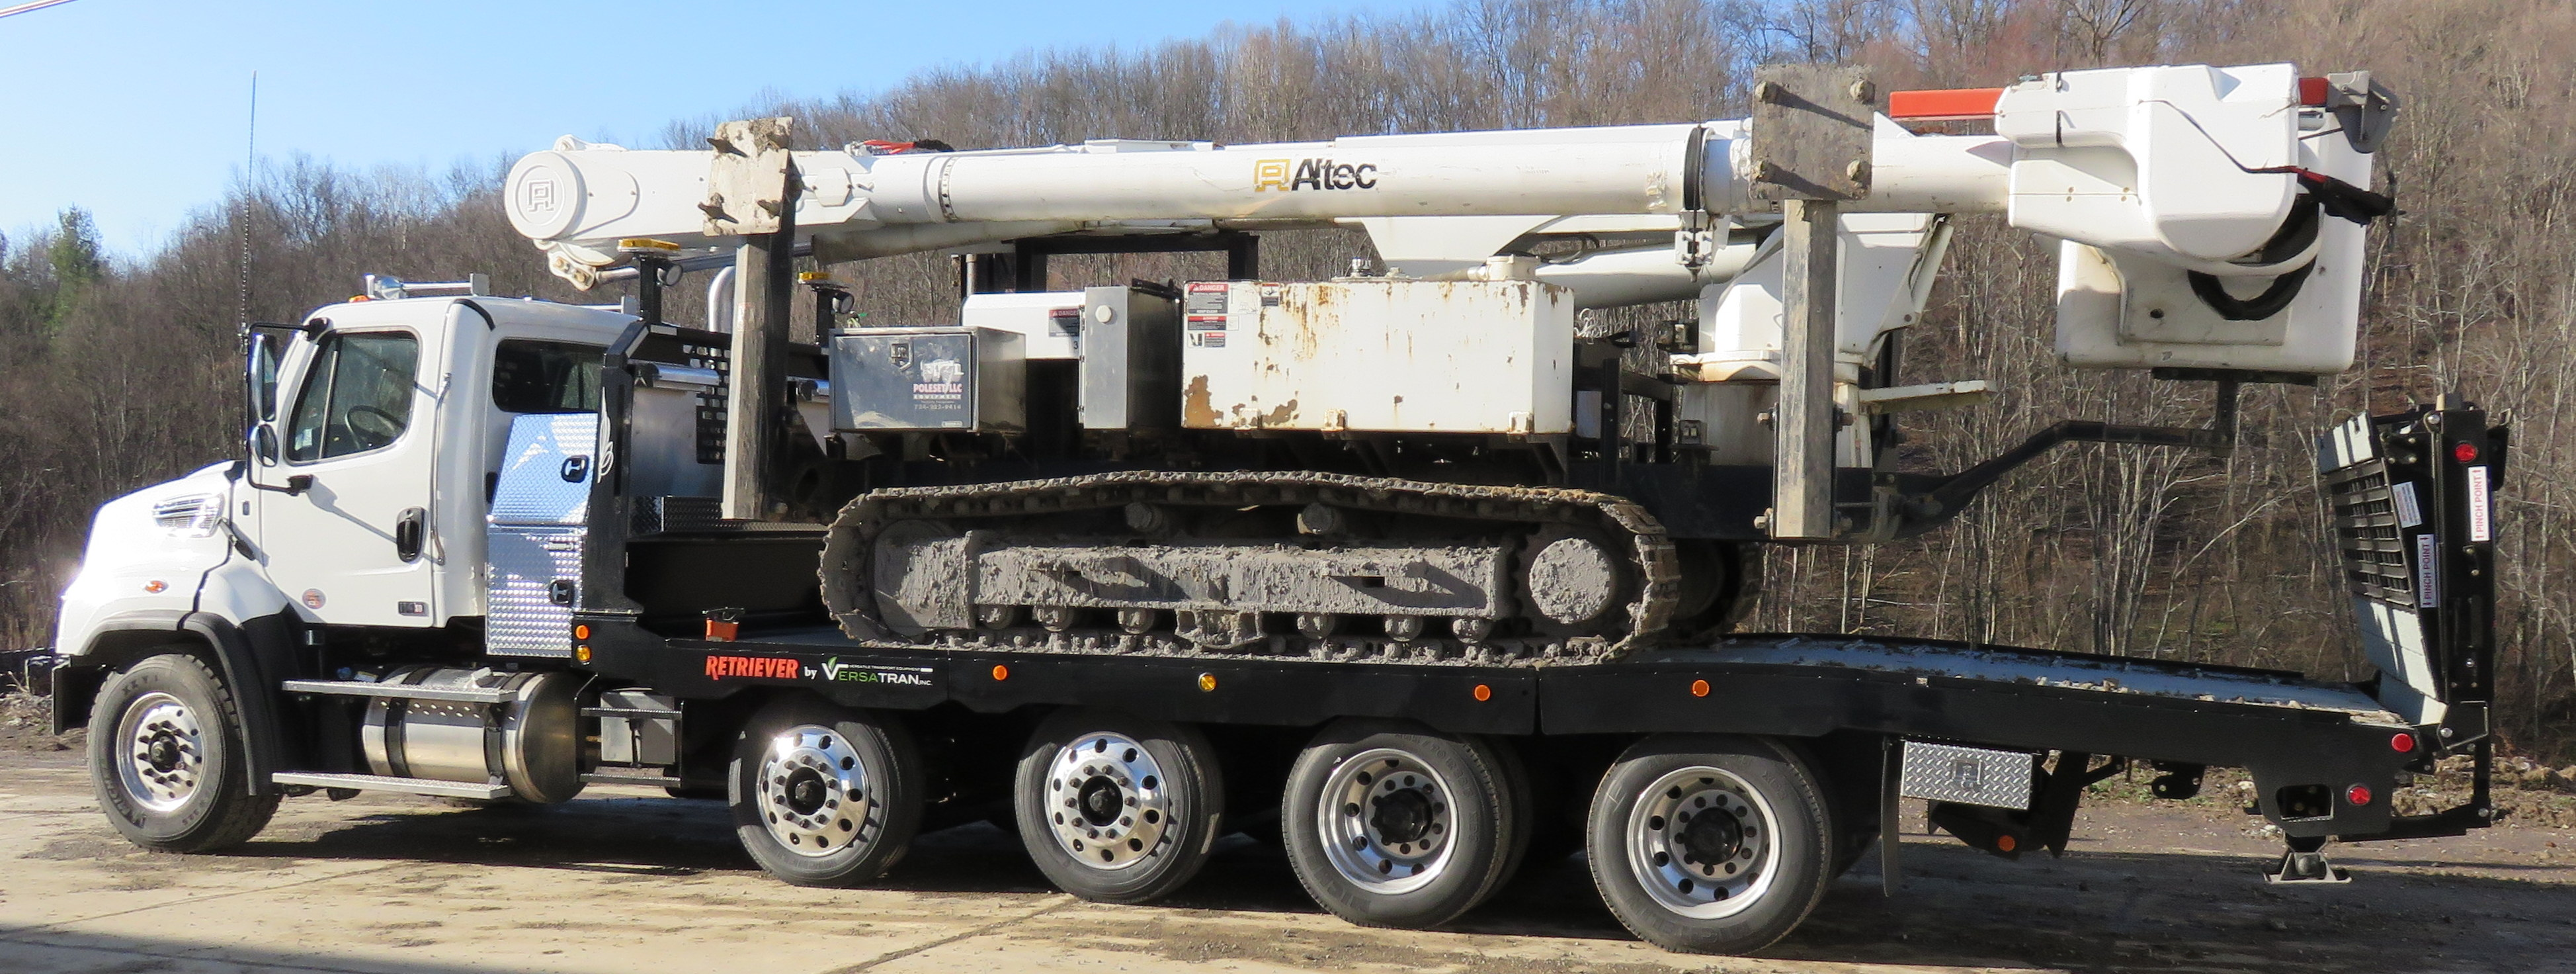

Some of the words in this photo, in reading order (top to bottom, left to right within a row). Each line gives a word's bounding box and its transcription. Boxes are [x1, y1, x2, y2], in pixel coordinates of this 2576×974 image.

[1291, 158, 1378, 191] Altec
[1073, 341, 1079, 349] 3
[949, 383, 963, 393] LLC
[2474, 474, 2483, 502] POINT
[2475, 504, 2484, 533] PINCH
[2421, 542, 2431, 570] POINT
[2423, 572, 2432, 601] PINCH
[705, 656, 798, 680] RETRIEVER
[804, 666, 817, 680] by
[821, 662, 919, 686] VERSATRAN
